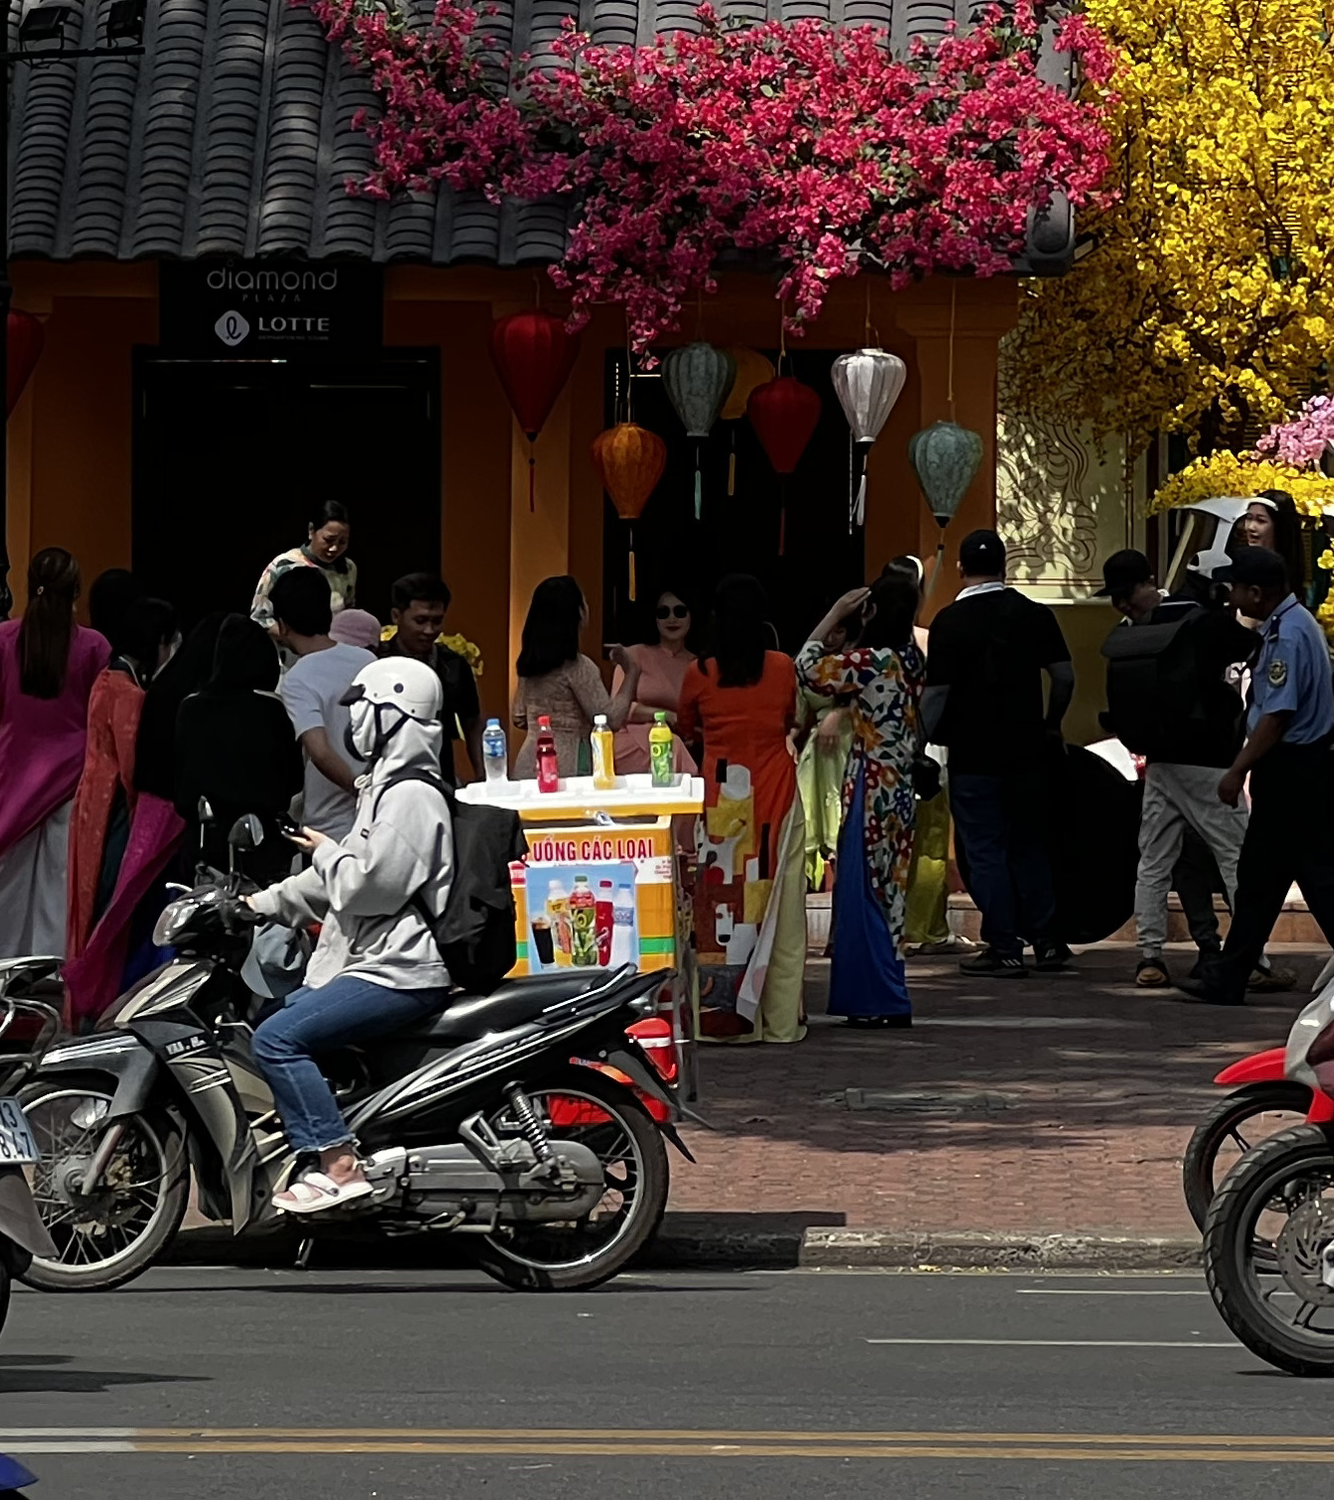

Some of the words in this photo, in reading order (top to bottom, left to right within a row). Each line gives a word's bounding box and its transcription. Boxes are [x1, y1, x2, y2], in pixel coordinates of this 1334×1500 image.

[206, 259, 338, 291] diamond
[258, 316, 330, 332] LOTTE
[533, 834, 576, 862] UỐNG
[581, 836, 613, 861] CÁC
